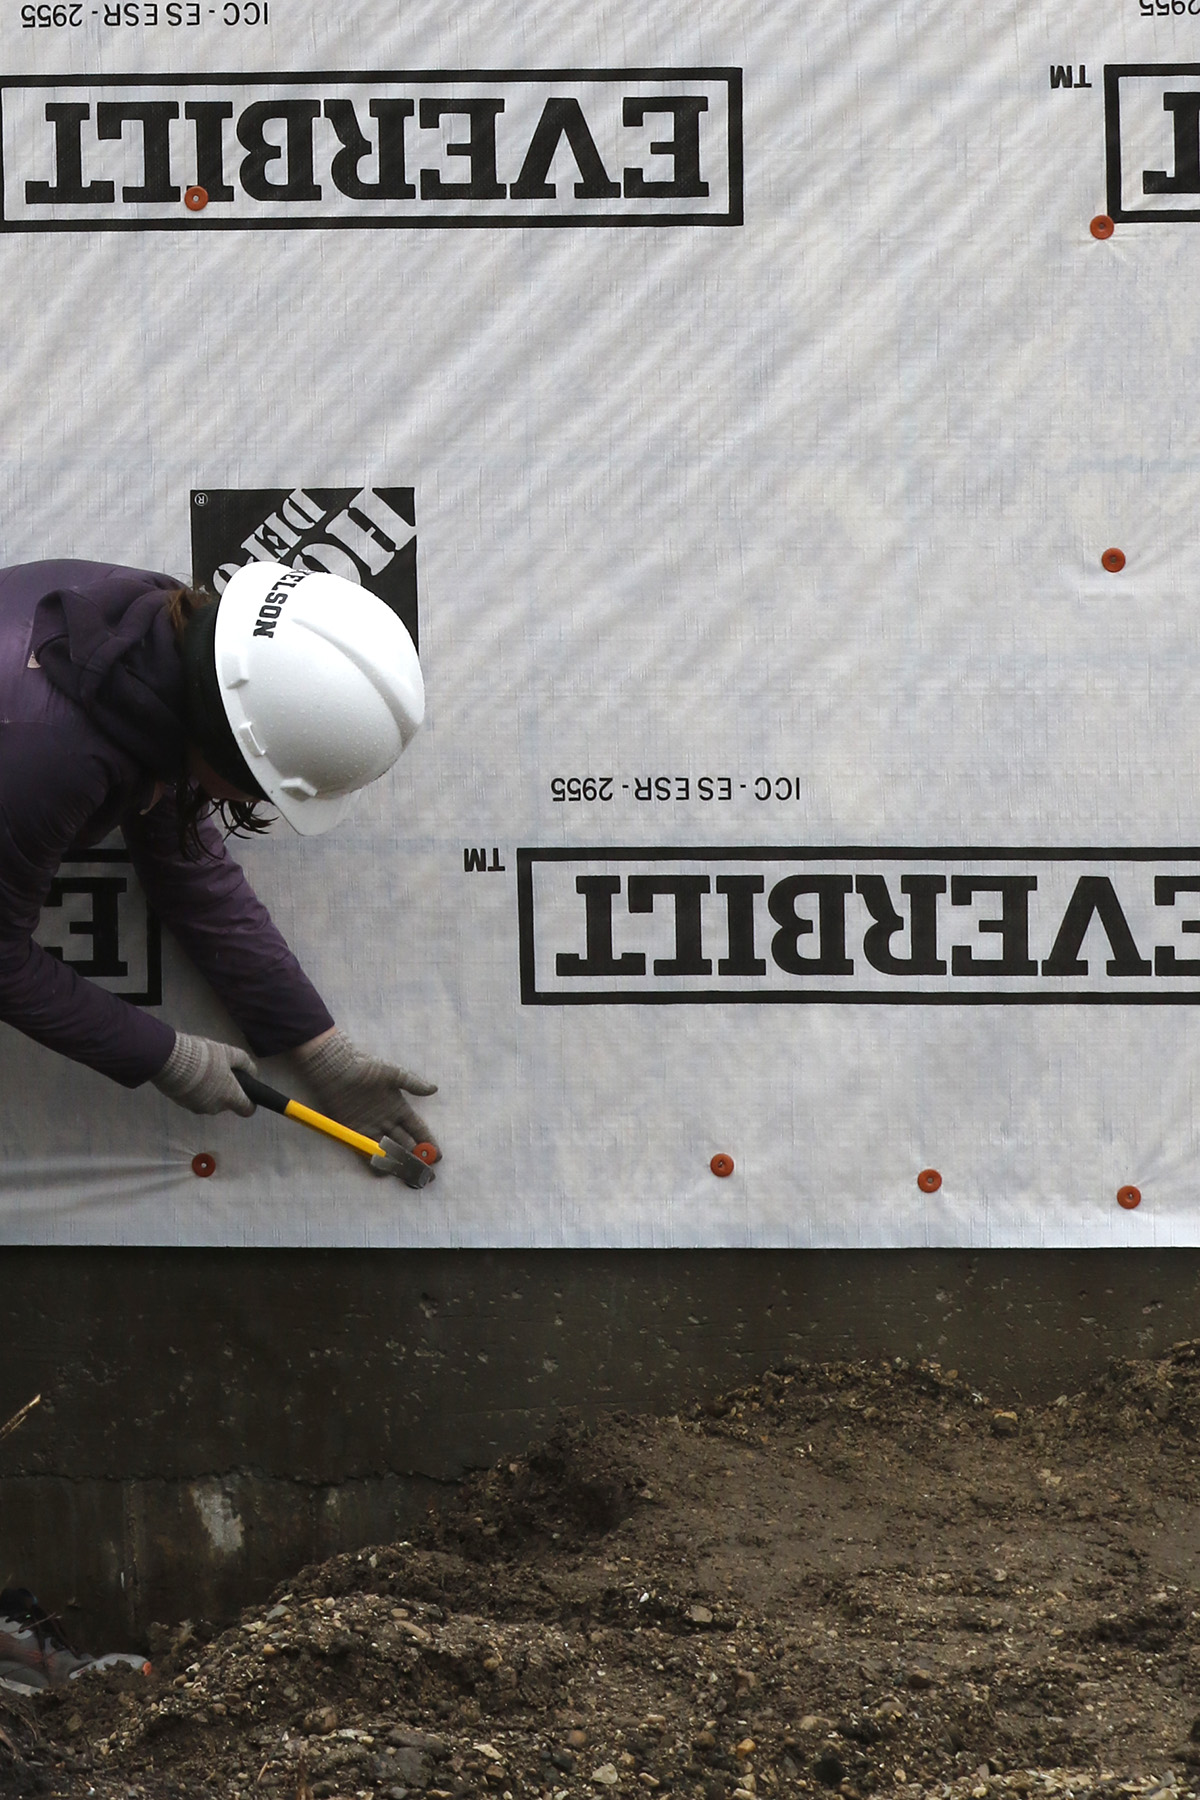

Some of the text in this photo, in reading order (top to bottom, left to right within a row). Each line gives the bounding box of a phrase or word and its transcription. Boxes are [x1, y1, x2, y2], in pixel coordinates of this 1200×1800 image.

[20, 3, 83, 29] 2955
[104, 3, 158, 27] ESR
[166, 2, 200, 27] ES
[224, 2, 268, 26] ICC
[25, 96, 710, 205] EVERBILT
[550, 777, 614, 802] 2955
[635, 776, 690, 801] ESR
[698, 776, 732, 801] ES
[755, 776, 800, 801] ICC
